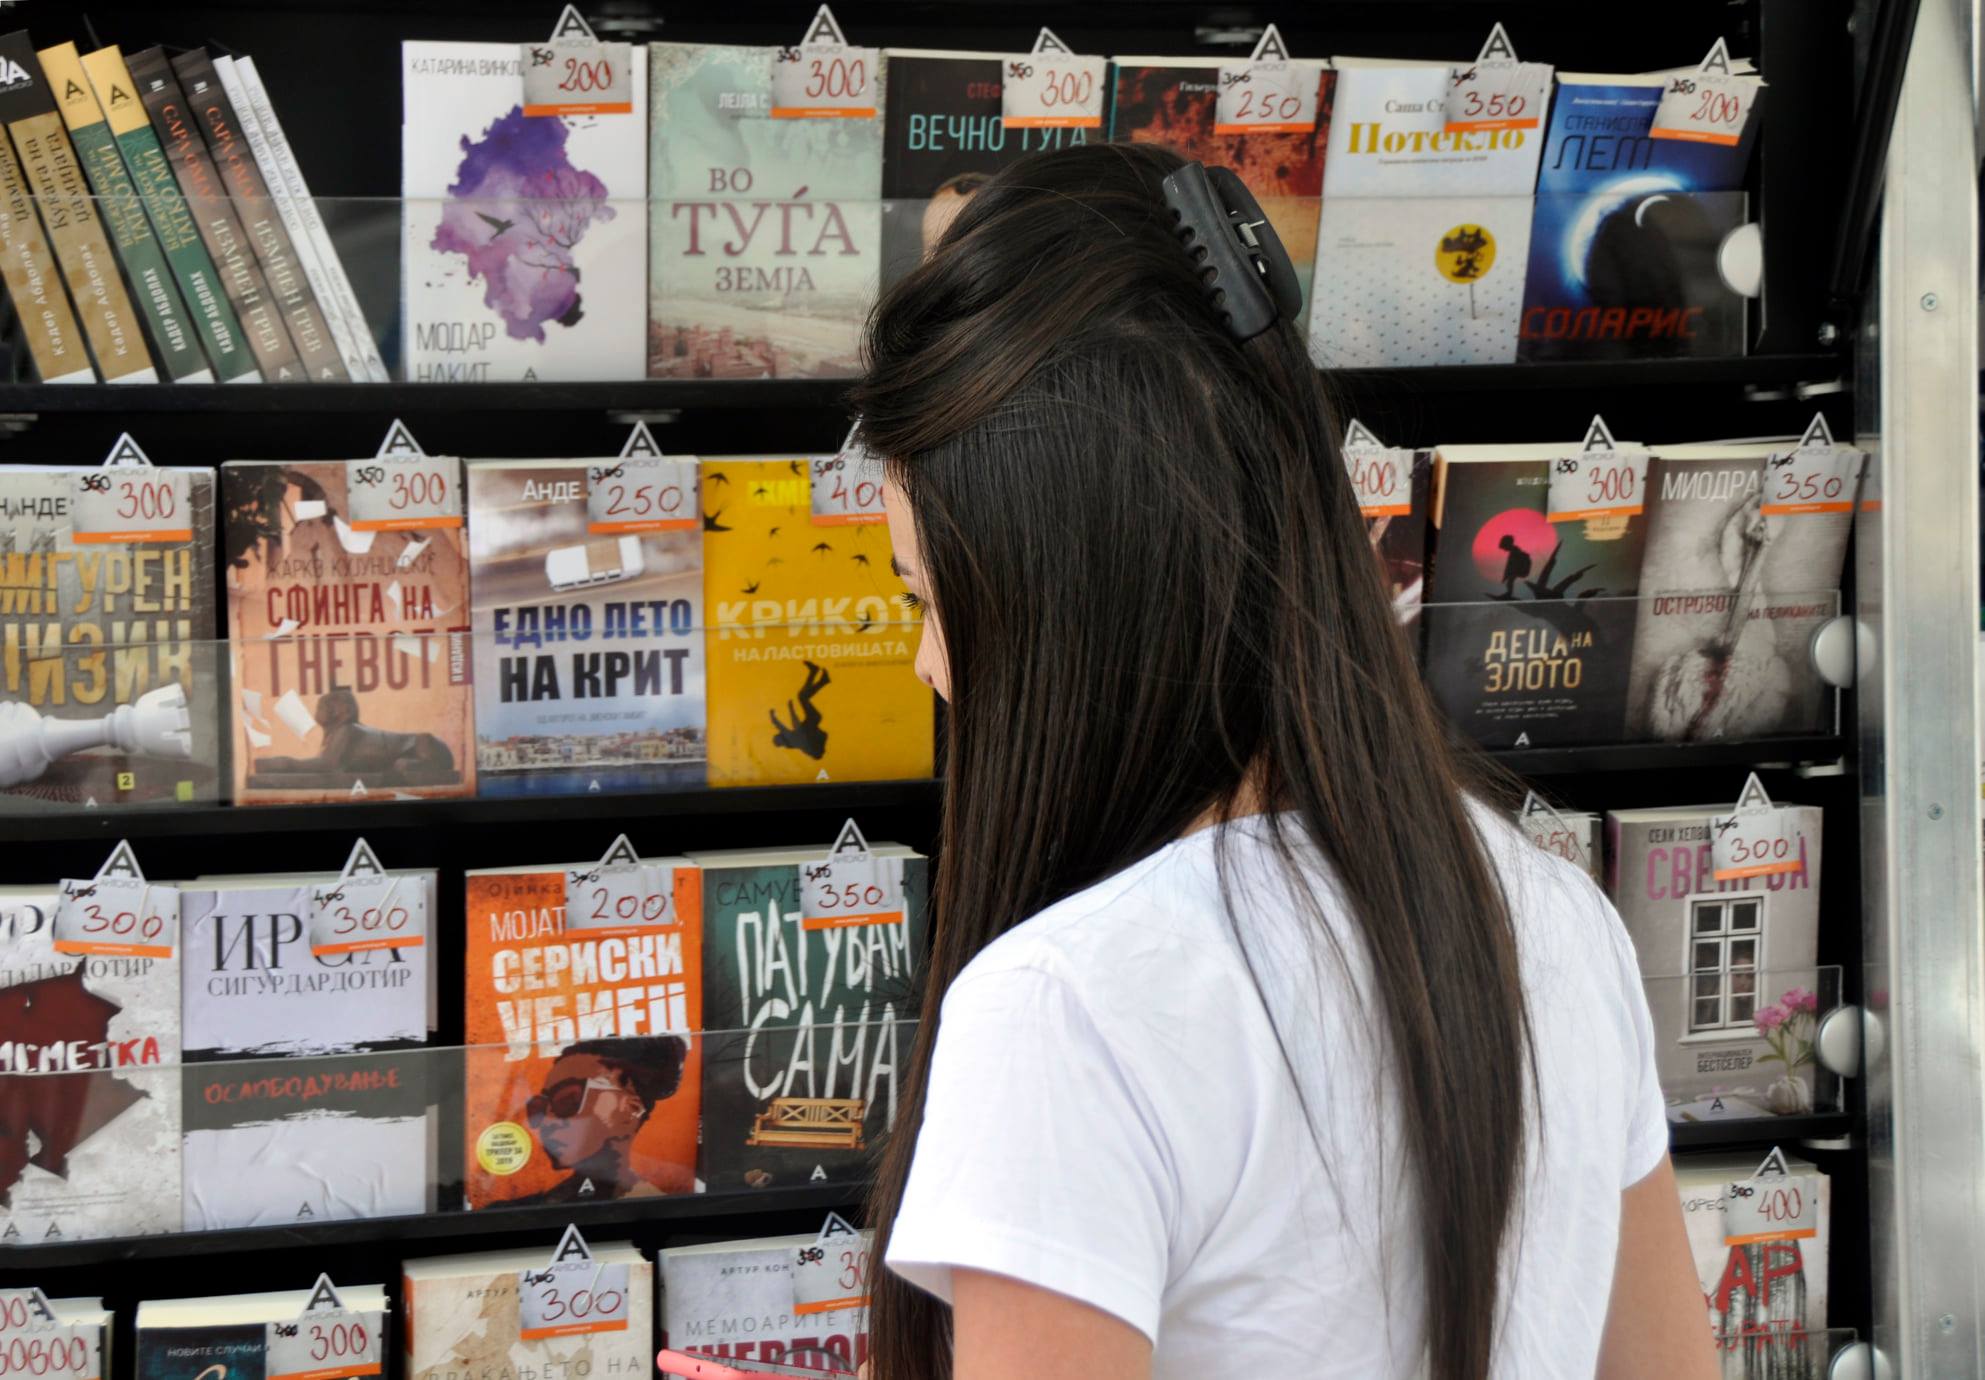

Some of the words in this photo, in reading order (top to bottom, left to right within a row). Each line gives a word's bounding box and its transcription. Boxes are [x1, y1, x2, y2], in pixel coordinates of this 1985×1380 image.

[411, 58, 477, 75] КАТАРИНА
[559, 58, 612, 92] 200
[806, 58, 865, 97] 300
[1040, 70, 1093, 107] 300
[1236, 91, 1301, 119] 250
[1385, 99, 1423, 114] Саша
[1464, 92, 1526, 117] 350
[1690, 90, 1739, 124] 200
[163, 105, 192, 152] САРА
[206, 106, 235, 155] САРА
[909, 115, 1005, 151] ВЕЧНО
[1553, 135, 1655, 171] ЛЕМ
[708, 166, 753, 193] ВО
[672, 185, 861, 257] ТУЃА
[210, 219, 260, 305] ИЗМИЕН
[250, 306, 279, 352] ГРЕВ
[254, 220, 302, 305] ИЗМИЕН
[292, 308, 322, 352] ГРЕВ
[715, 266, 816, 297] ЗЕМЈА
[42, 311, 64, 356] Кадер
[104, 311, 127, 356] Кадер
[163, 319, 187, 352] КАДЕР
[211, 321, 235, 353] КАДЕР
[416, 322, 496, 353] МОДАР
[1520, 306, 1704, 341] СОЛАРИС
[389, 472, 446, 510] 300
[1352, 459, 1396, 497] 400
[1588, 467, 1634, 503] 300
[1776, 473, 1842, 500] 350
[117, 482, 175, 519] 300
[606, 486, 684, 516] 250
[267, 583, 385, 629] СФИНГА
[403, 586, 434, 621] НА
[494, 603, 592, 650] ЕДНО
[603, 598, 692, 640] ЛЕТО
[716, 596, 915, 640] КРИКОТ
[269, 629, 435, 697] ГНЕВОТ
[734, 647, 760, 662] НА
[762, 641, 908, 660] ЛАСТОВИЦАТА
[1484, 629, 1568, 663] ДЕЦА
[1571, 631, 1593, 648] НА
[500, 655, 560, 703] НА
[573, 648, 690, 699] КРИТ
[1484, 658, 1582, 692] ЗЛОТО
[1647, 836, 1808, 900] СВЕА
[1731, 838, 1788, 862] 300
[591, 889, 666, 921] 200
[818, 883, 883, 908] 350
[82, 905, 163, 938] 300
[334, 907, 408, 934] 300
[490, 906, 566, 942] МОЈАТ
[211, 913, 405, 971] ИР
[492, 932, 683, 994] СЕРИСКИ
[737, 898, 911, 1026] ПАТУВАМ
[207, 969, 411, 996] СИГУРДАРДОТИР
[497, 982, 691, 1061] УБИЕЦ
[744, 999, 897, 1132] САМА
[204, 1067, 400, 1104] ОСЛОБОДУВАЊЕ
[1758, 1188, 1802, 1222] 400
[721, 1264, 760, 1276] АРТУР
[1704, 1245, 1803, 1313] АР
[467, 1288, 508, 1298] АРТУР
[541, 1288, 621, 1321] 300
[310, 1323, 367, 1360] 300
[685, 1310, 835, 1337] МЕМОАРИТЕ
[608, 1358, 640, 1374] НА
